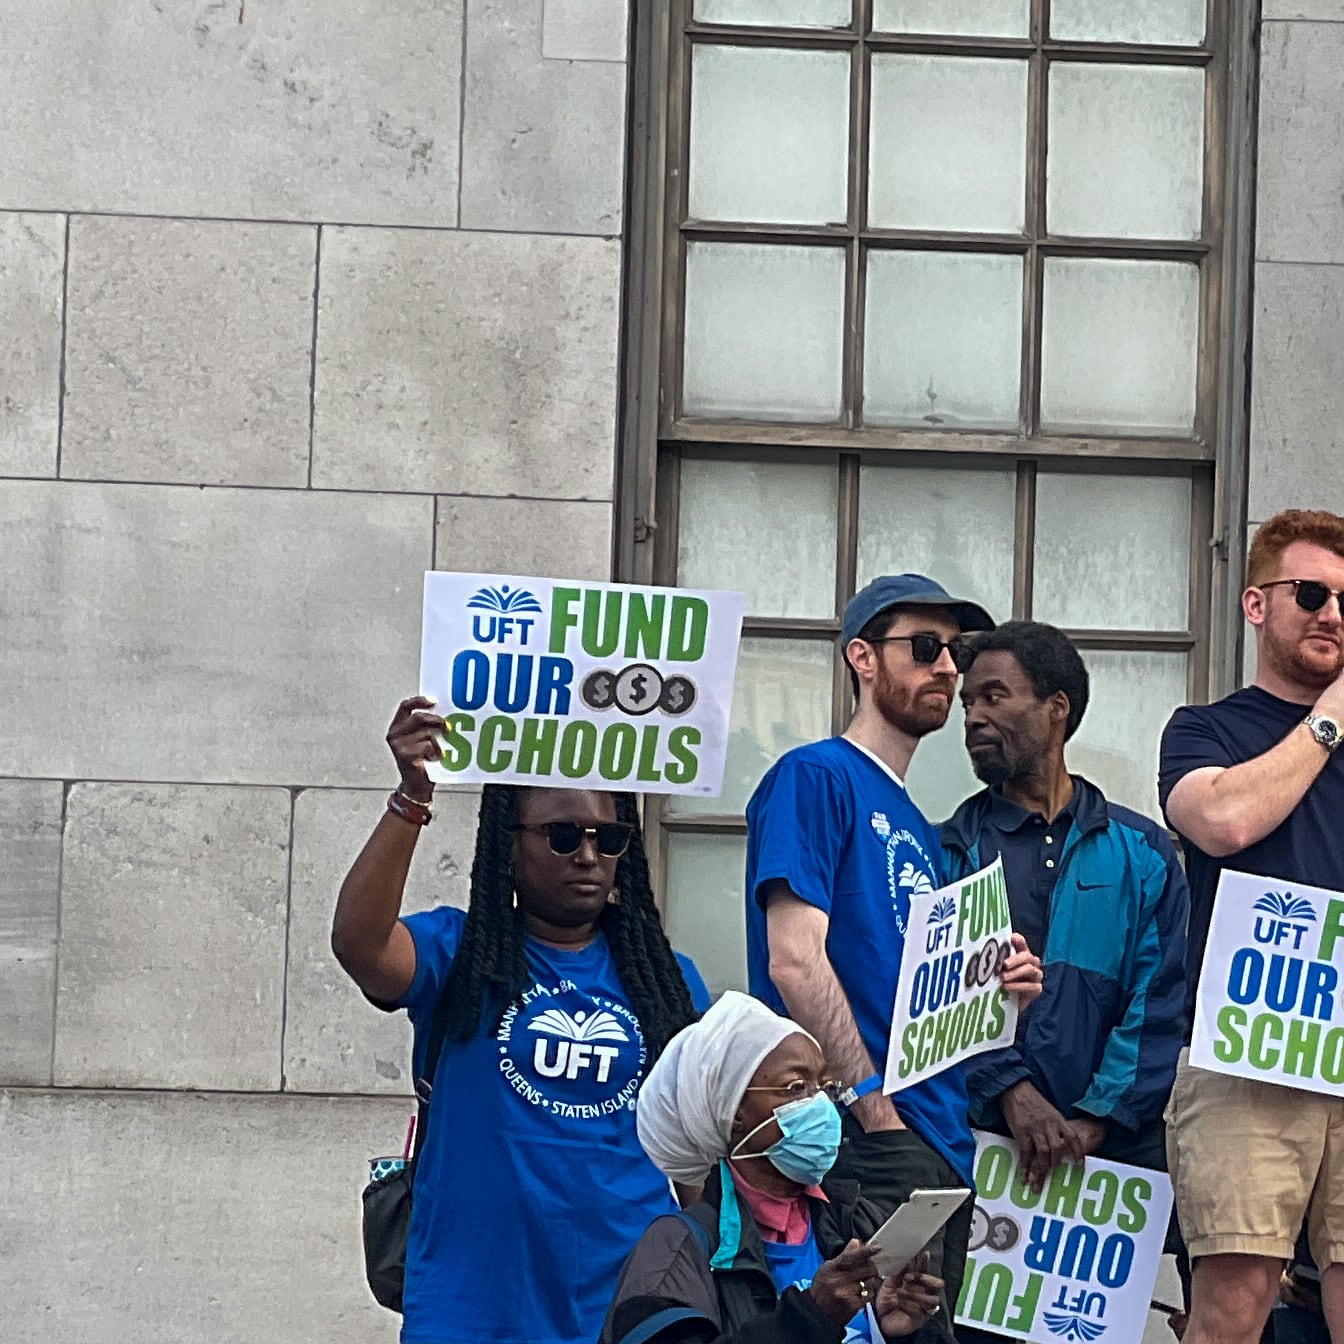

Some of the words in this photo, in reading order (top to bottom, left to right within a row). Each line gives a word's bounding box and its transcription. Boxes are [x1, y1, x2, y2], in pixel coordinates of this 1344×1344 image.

[472, 615, 534, 645] UFT
[548, 586, 709, 662] FUND
[451, 649, 574, 715] OUR
[441, 712, 701, 784] SCHOOLS
[926, 922, 953, 954] UFT
[1253, 917, 1308, 950] UFT
[909, 950, 964, 1019] OUR
[1227, 947, 1338, 1021] OUR
[533, 1038, 620, 1082] UFT
[898, 989, 1011, 1079] SCHOOLS
[499, 1058, 543, 1105] QUEENS
[551, 1100, 600, 1119] STATEN
[601, 1078, 639, 1115] ISLAND
[975, 1145, 1152, 1233] SCHOO
[1024, 1215, 1135, 1288] OUR
[1052, 1285, 1107, 1318] UFT
